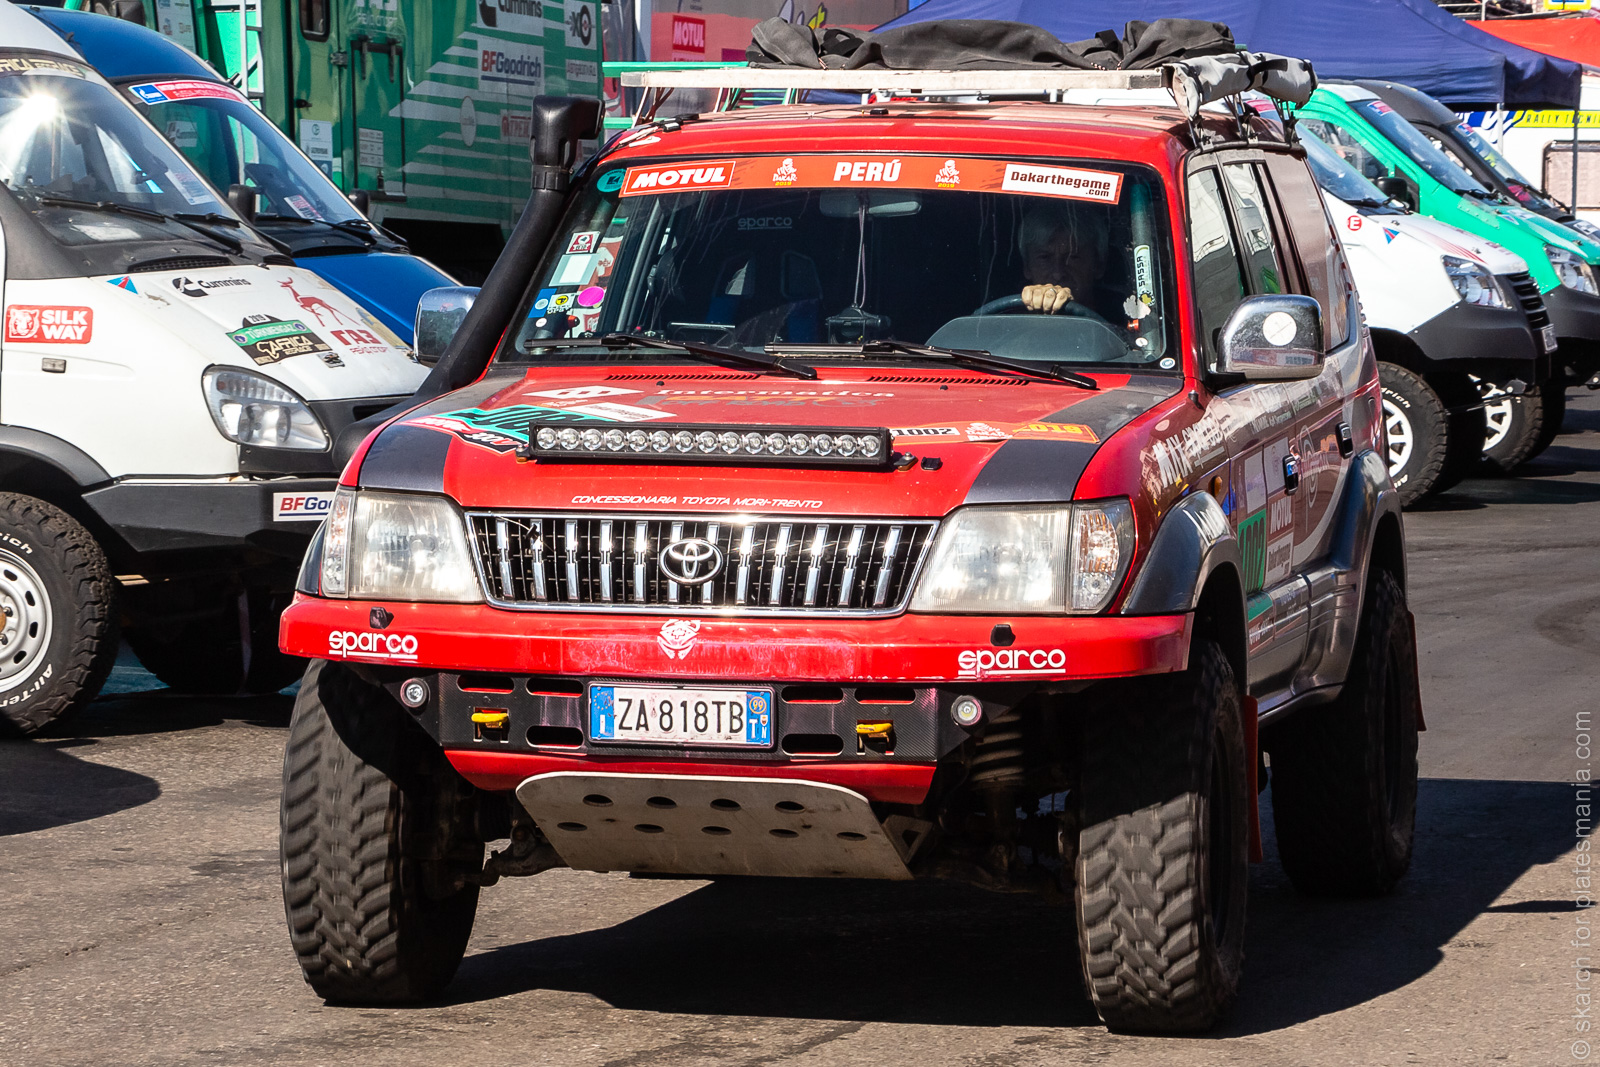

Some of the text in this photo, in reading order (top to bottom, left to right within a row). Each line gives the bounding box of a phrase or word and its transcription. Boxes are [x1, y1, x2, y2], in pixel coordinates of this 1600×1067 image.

[673, 21, 705, 48] MOTUL
[481, 50, 541, 78] BFGoodrich
[772, 173, 798, 182] DAKAR
[833, 158, 902, 182] PERÚ
[630, 167, 728, 189] MOTUL
[935, 173, 961, 184] DAKAR
[1010, 170, 1112, 190] Dakarthegame
[1085, 187, 1110, 197] .com
[737, 216, 793, 228] sparco
[200, 277, 252, 289] Cummins
[41, 309, 88, 325] SILK
[41, 325, 88, 340] WAY
[330, 329, 383, 345] ГАЗ
[890, 428, 953, 436] 1002
[1012, 422, 1083, 434] 2019
[280, 496, 333, 511] BFGo
[571, 495, 824, 508] CONCESSIONARIA TOYOTA MORI-TRENTO
[1270, 497, 1292, 535] MOTUL
[328, 630, 418, 657] sparco
[957, 648, 1067, 674] sparco
[752, 700, 764, 711] 99
[618, 698, 744, 734] ZA 818TB
